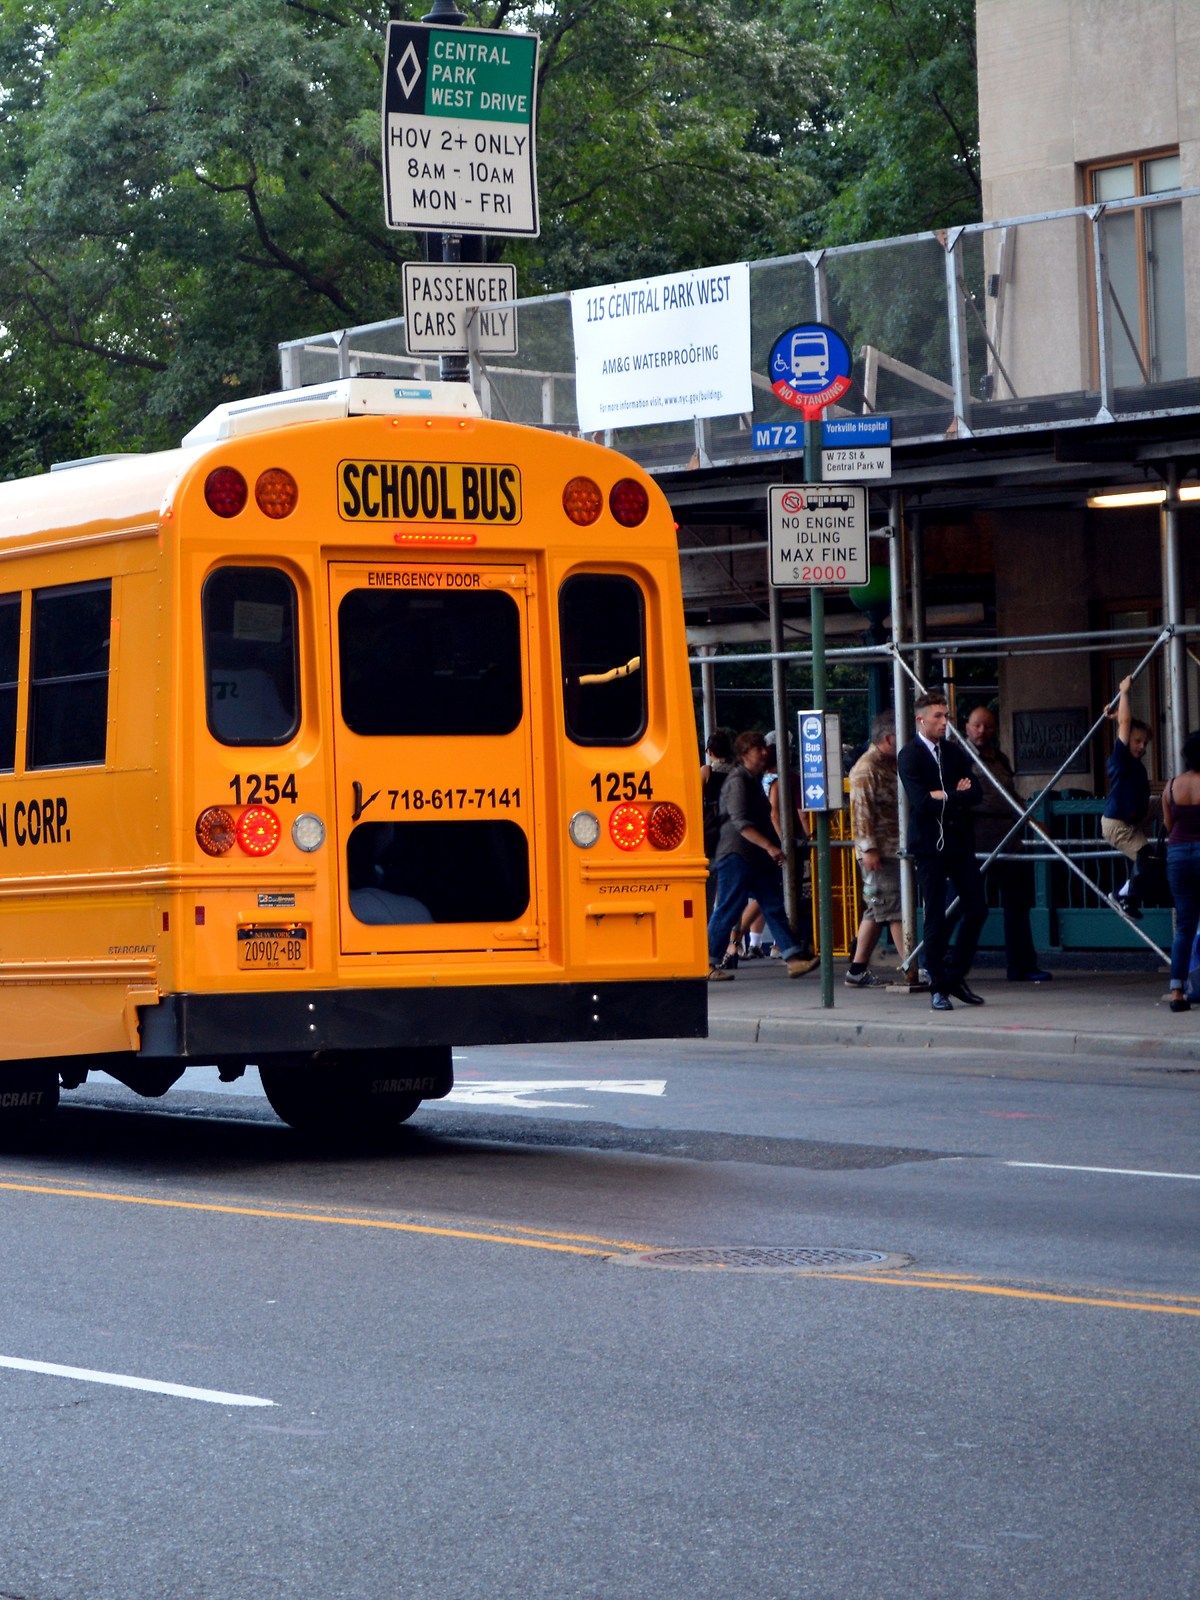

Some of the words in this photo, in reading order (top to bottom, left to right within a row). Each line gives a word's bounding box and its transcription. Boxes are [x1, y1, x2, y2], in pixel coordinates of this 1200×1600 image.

[434, 41, 511, 65] CENTRAL
[432, 64, 477, 85] PARK
[432, 88, 474, 108] WEST
[480, 92, 527, 112] DRIVE
[391, 127, 431, 149] HOV
[441, 130, 468, 151] 2+
[474, 133, 526, 156] ONLY
[408, 158, 446, 180] 8AM
[469, 162, 514, 184] 10AM
[412, 188, 456, 210] MON
[480, 193, 512, 214] FRI
[412, 277, 508, 302] PASSENGER
[586, 296, 605, 322] 115
[608, 288, 660, 318] CENTRAL
[663, 282, 694, 310] PARK
[696, 276, 731, 304] WEST
[414, 312, 456, 336] CARS
[480, 312, 508, 336] NLY
[602, 356, 630, 375] AM&G
[632, 344, 719, 370] WATERPROOFING
[778, 386, 794, 400] NO
[796, 382, 844, 405] STANDING
[607, 404, 619, 412] more
[619, 400, 649, 410] information
[756, 426, 797, 446] M72
[826, 424, 856, 433] Yorkville
[858, 422, 888, 432] Hospital
[826, 462, 854, 472] Central
[856, 462, 874, 470] Park
[343, 463, 456, 520] SCHOOL
[462, 466, 516, 522] BUS
[782, 518, 800, 529] NO
[806, 516, 855, 528] ENGINE
[797, 532, 840, 544] IDLING
[780, 548, 814, 562] MAX
[822, 548, 857, 562] FINE
[368, 572, 442, 587] EMERGENCY
[446, 573, 480, 587] DOOR
[792, 566, 846, 580] $2000
[806, 742, 820, 752] Bus
[804, 754, 822, 764] Stop
[230, 773, 298, 805] 1254
[590, 770, 654, 802] 1254
[388, 788, 521, 810] 718-617-7141
[14, 797, 71, 847] CORP.
[599, 884, 671, 894] STARCRAFT
[108, 944, 156, 954] STARCRAFT
[244, 940, 279, 961] 20902
[372, 1076, 438, 1093] STARCRAFT
